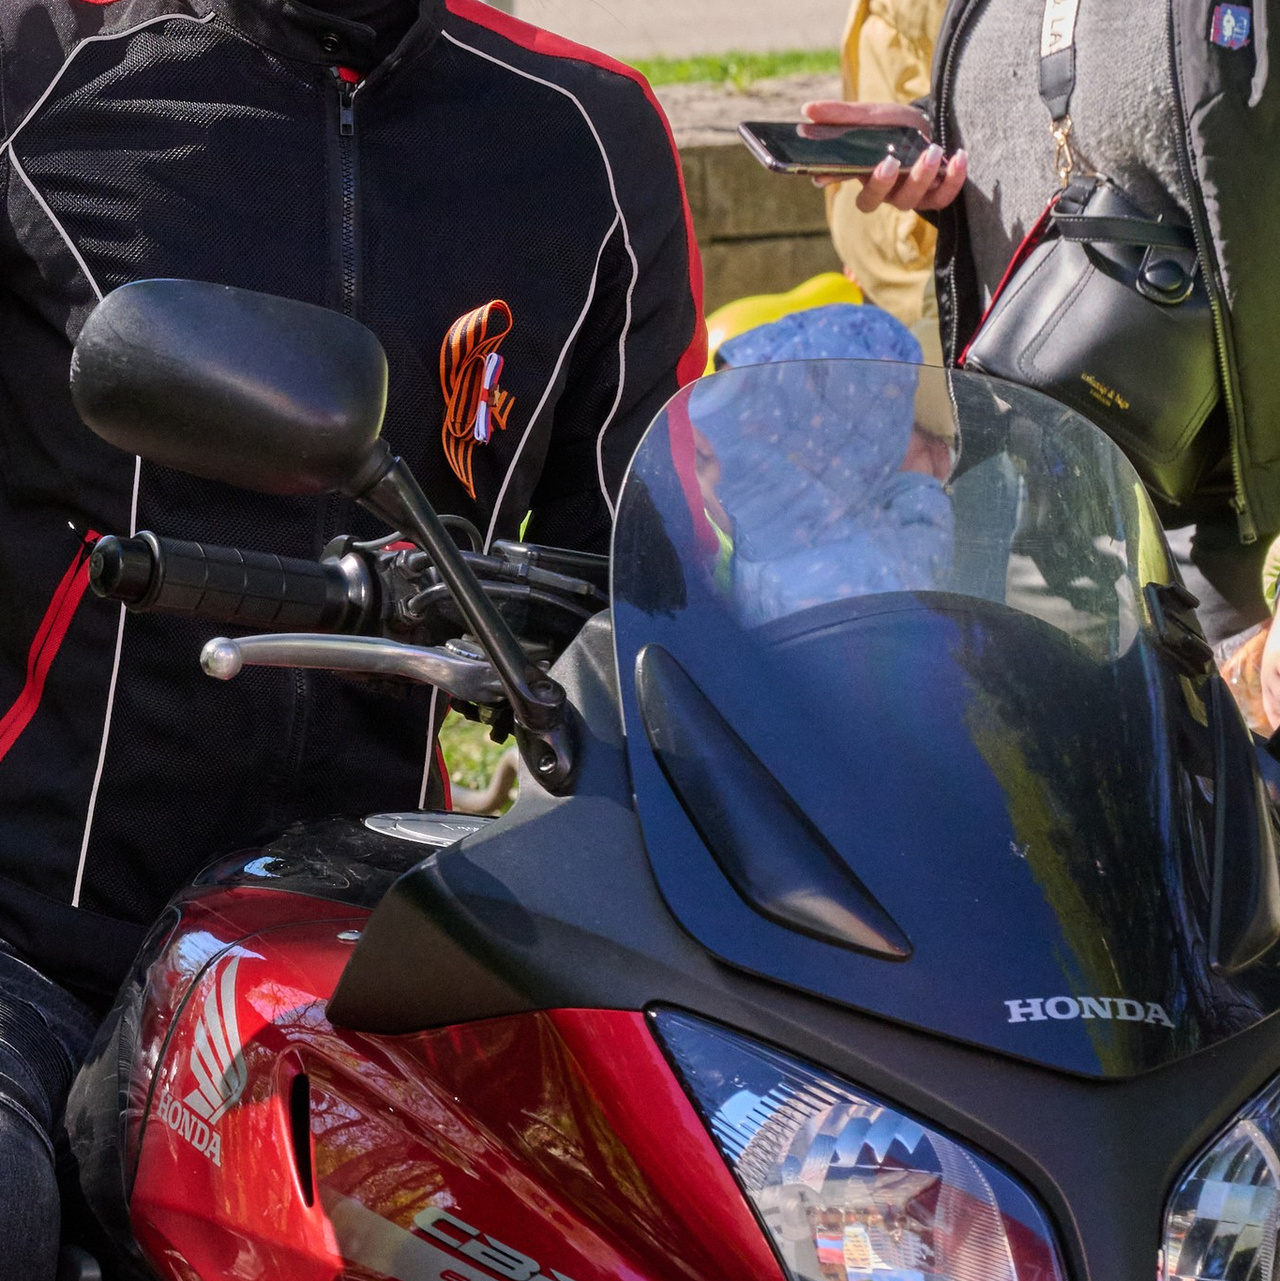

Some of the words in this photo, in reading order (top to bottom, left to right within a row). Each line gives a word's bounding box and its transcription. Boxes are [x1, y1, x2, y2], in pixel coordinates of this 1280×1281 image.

[1049, 16, 1066, 54] LA
[1004, 996, 1176, 1029] HONDA
[156, 1089, 221, 1167] HONDA
